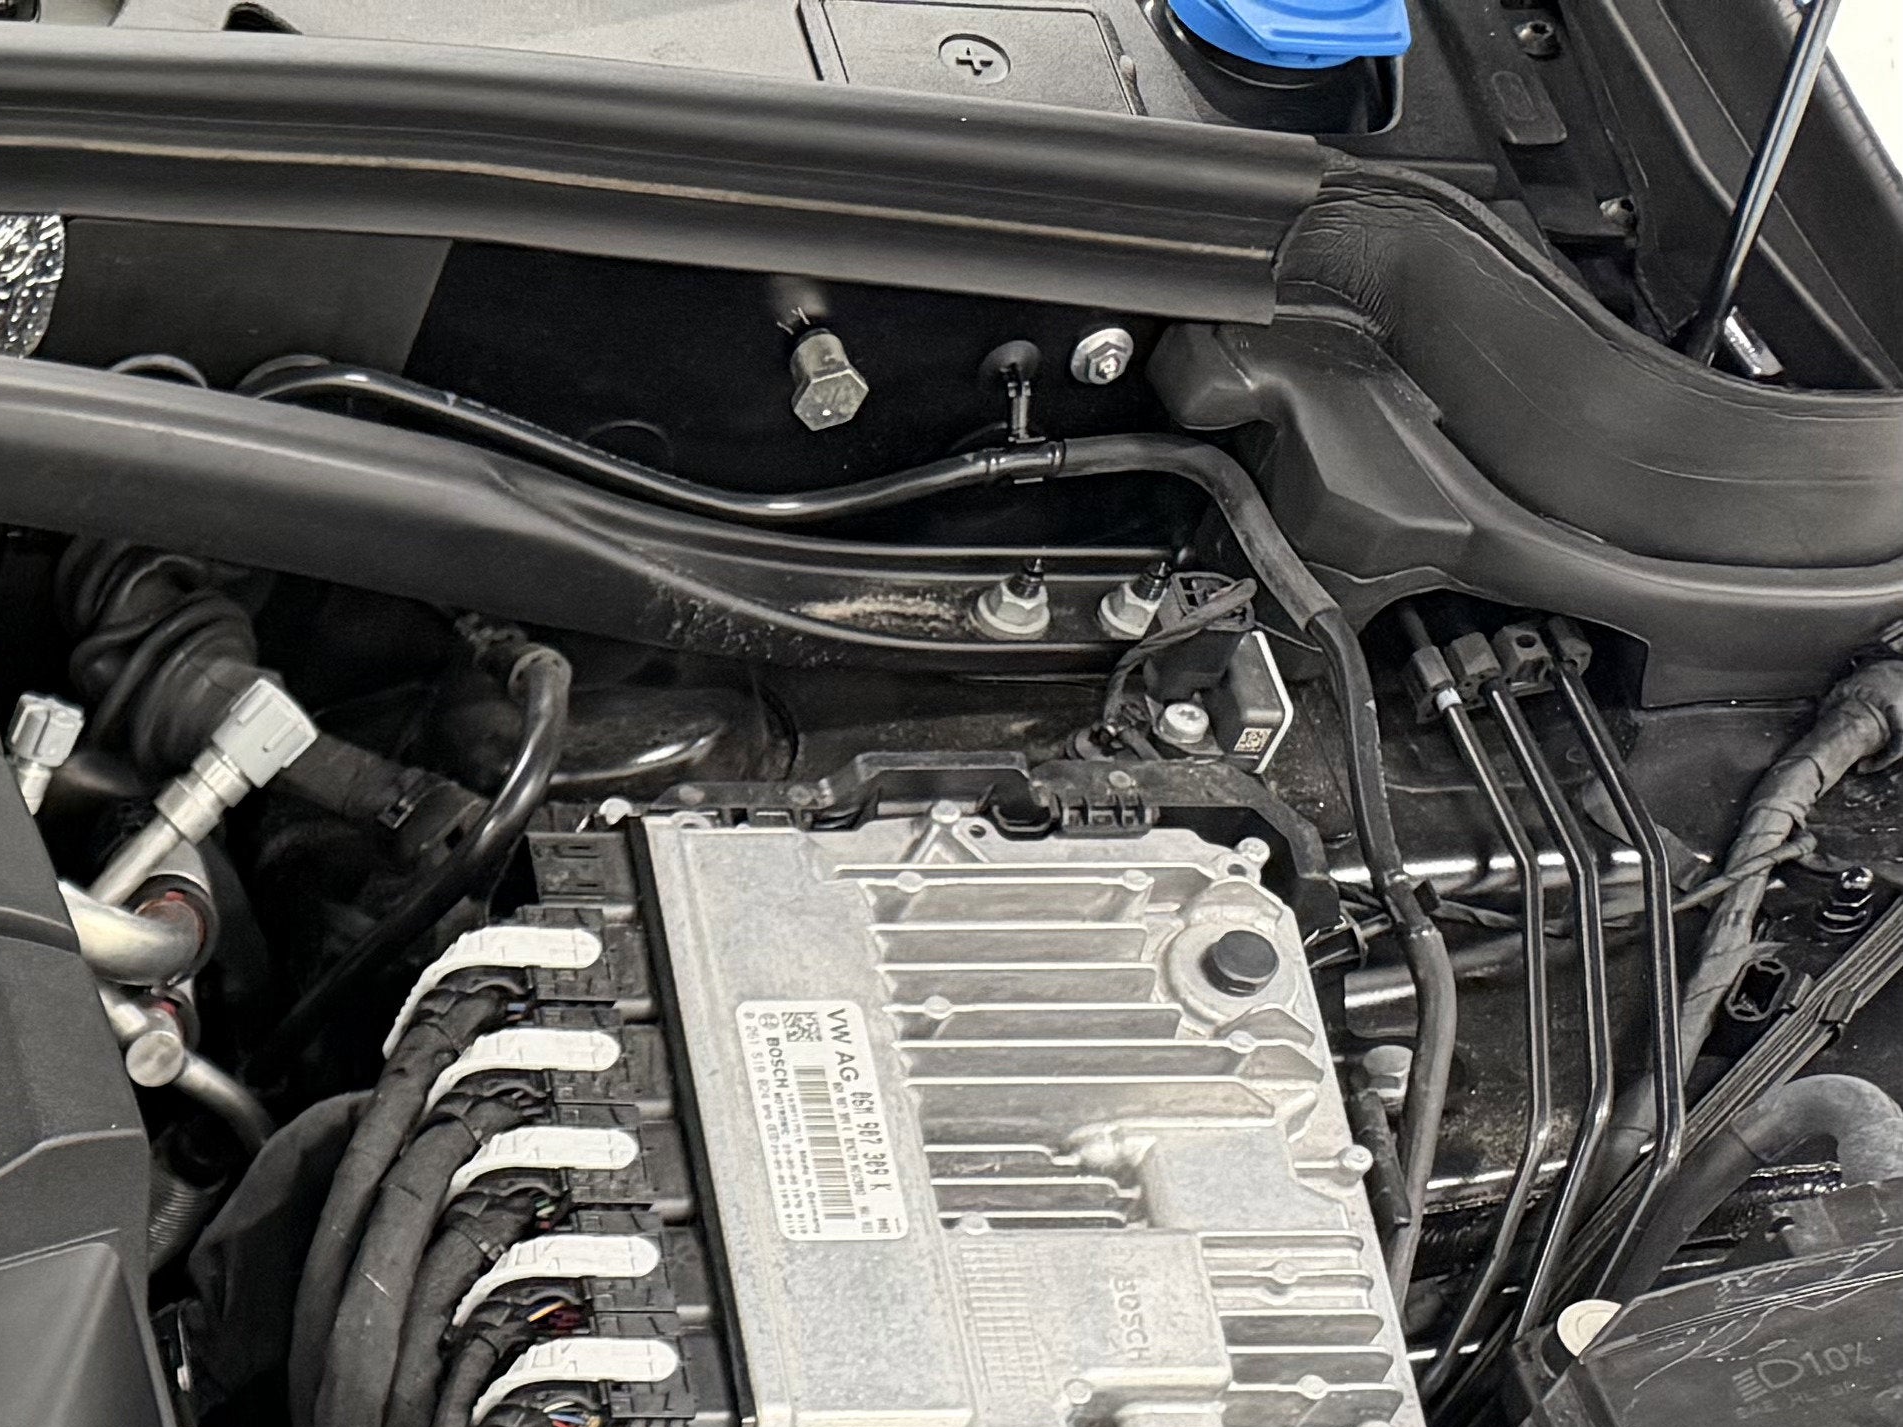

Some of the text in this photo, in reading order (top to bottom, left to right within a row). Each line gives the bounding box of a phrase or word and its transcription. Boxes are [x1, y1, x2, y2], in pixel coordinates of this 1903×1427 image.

[827, 1008, 853, 1044] VW
[765, 1036, 790, 1089] BOSCH
[835, 1050, 859, 1083] AG
[856, 1121, 884, 1145] 907
[862, 1152, 891, 1176] 309
[869, 1183, 892, 1191] K
[1113, 1275, 1151, 1362] BOSCH
